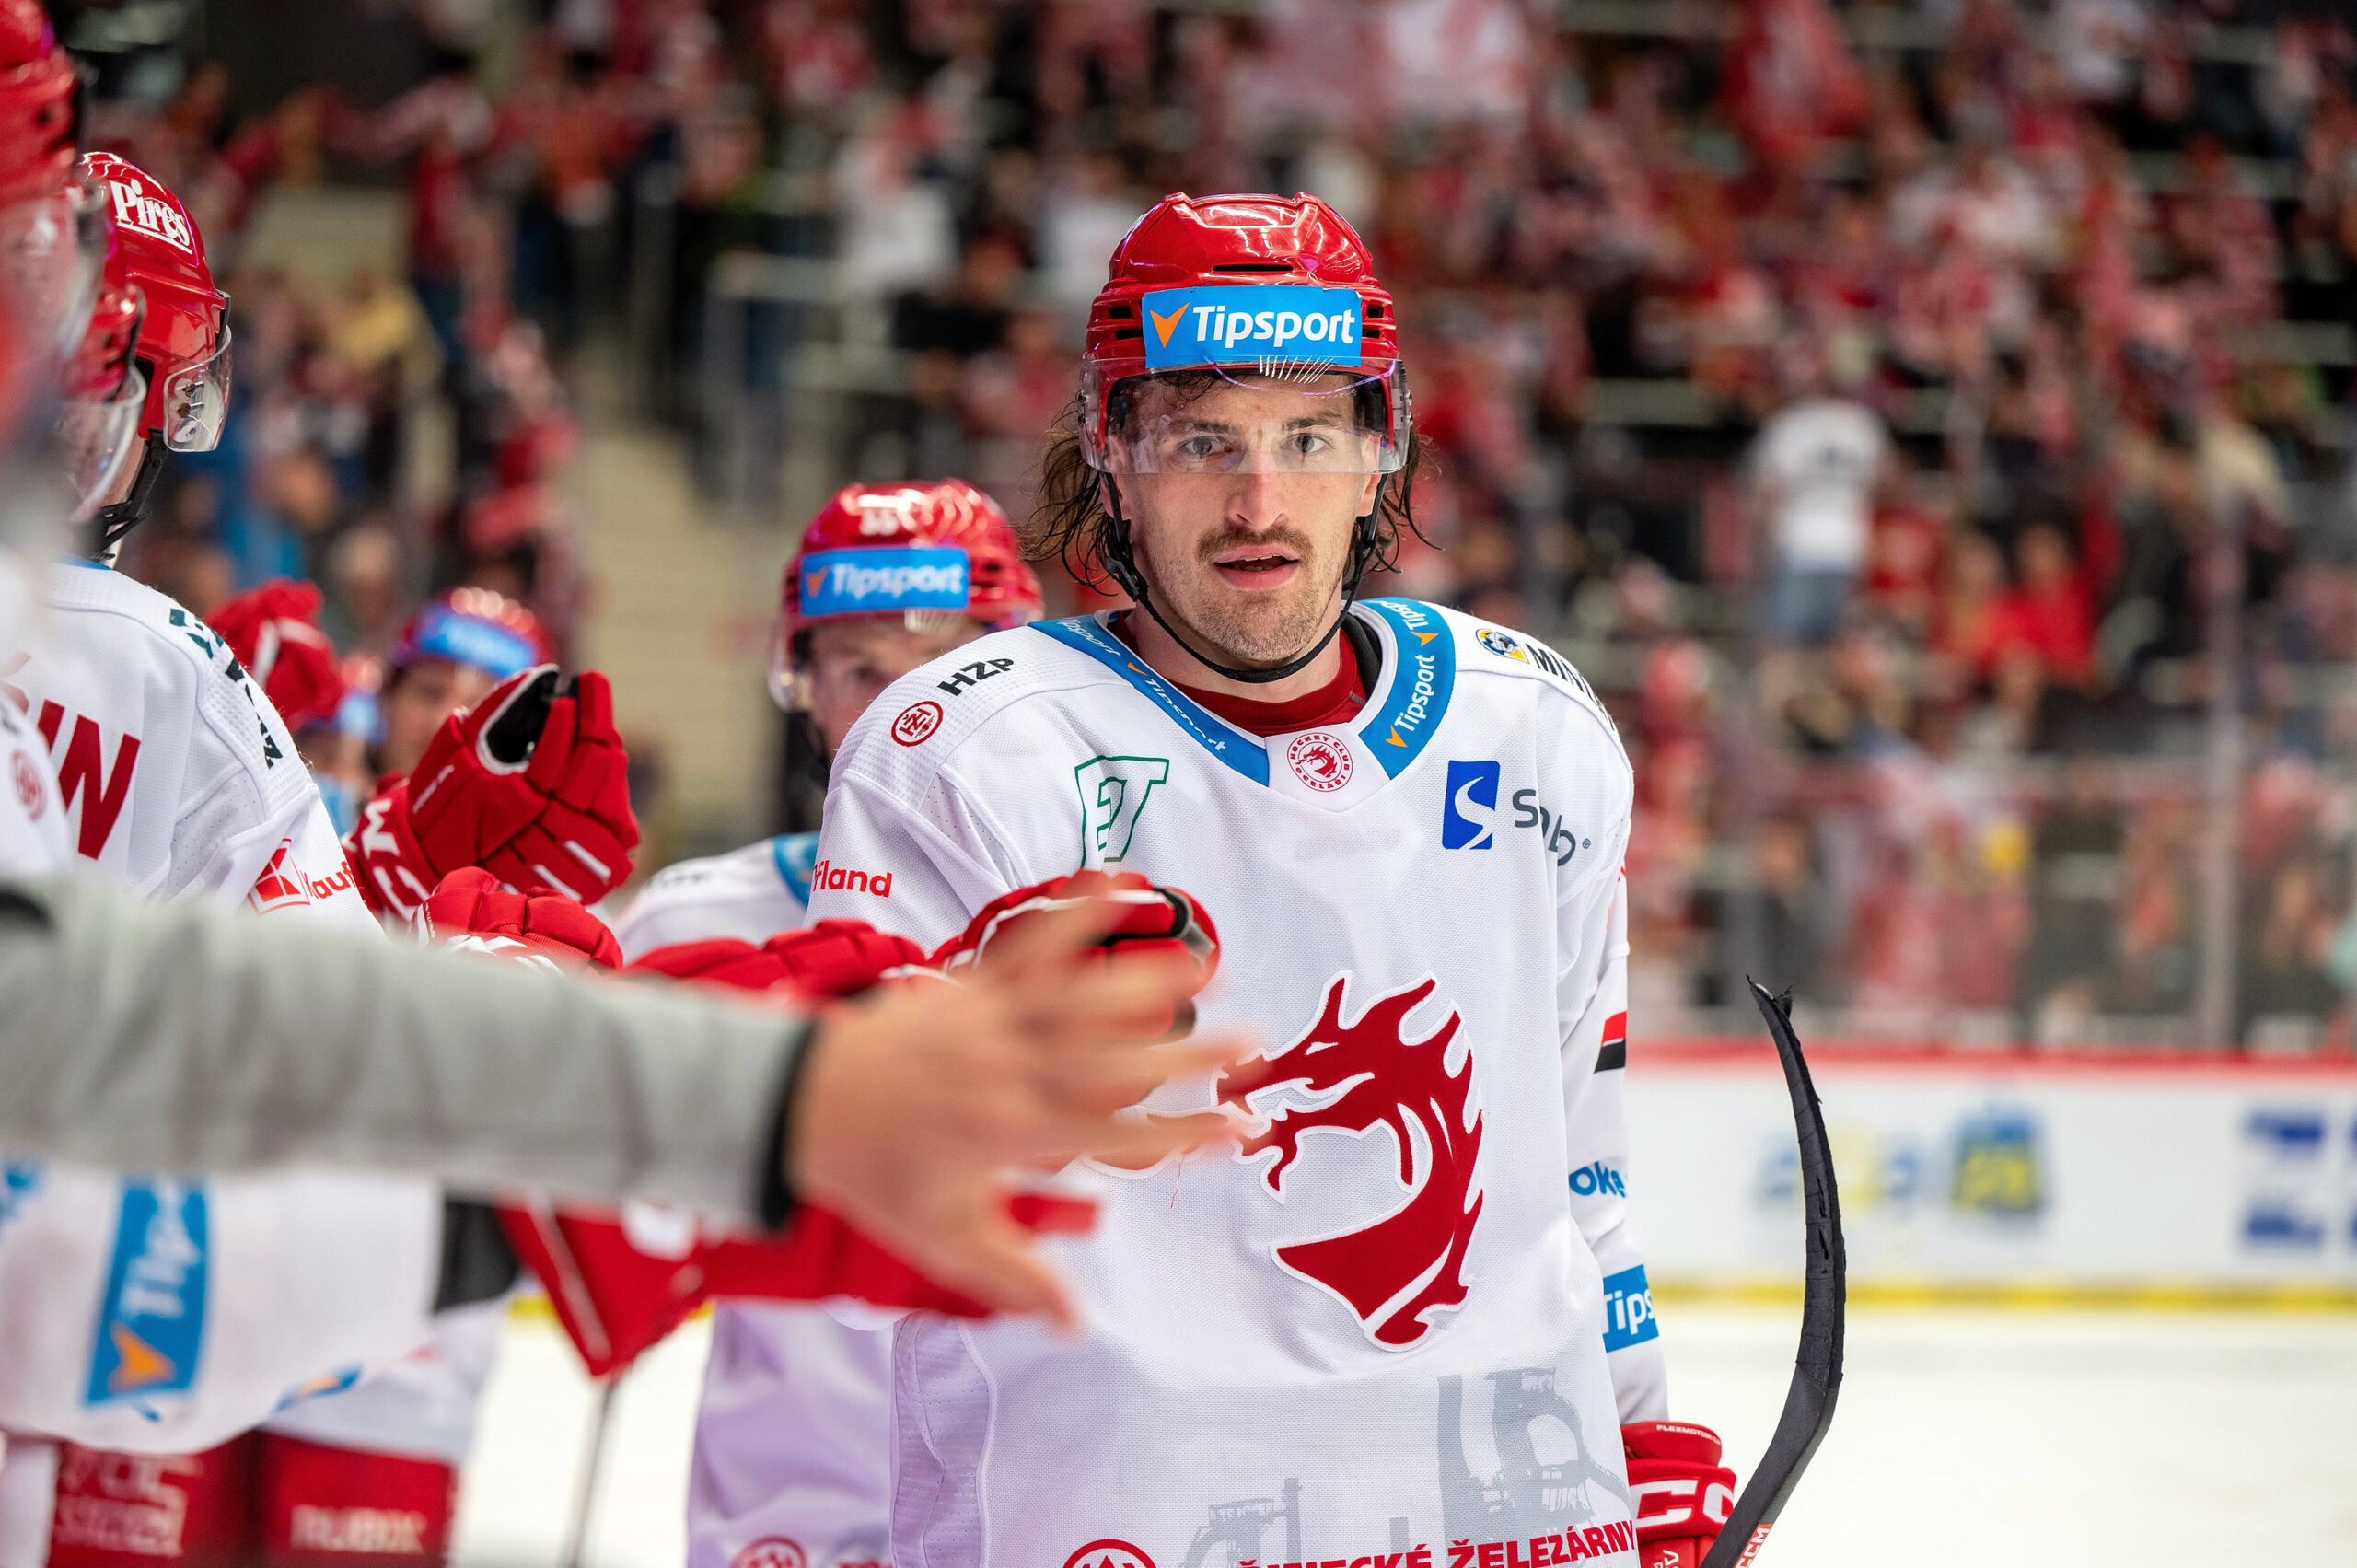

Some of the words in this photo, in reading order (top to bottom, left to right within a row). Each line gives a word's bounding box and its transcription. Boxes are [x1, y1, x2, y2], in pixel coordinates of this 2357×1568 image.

[110, 179, 190, 246] Pires
[1192, 305, 1355, 349] Tipsport
[832, 563, 964, 599] Tipsport
[936, 658, 1015, 697] HZP
[1394, 655, 1435, 732] Tipsport
[1145, 679, 1227, 754] Tipsport
[1290, 735, 1329, 760] HOCKEY
[1333, 741, 1350, 771] CLUB
[1447, 1520, 1635, 1568] ŽELEZÁRNY
[1736, 1527, 1771, 1568] CCM
